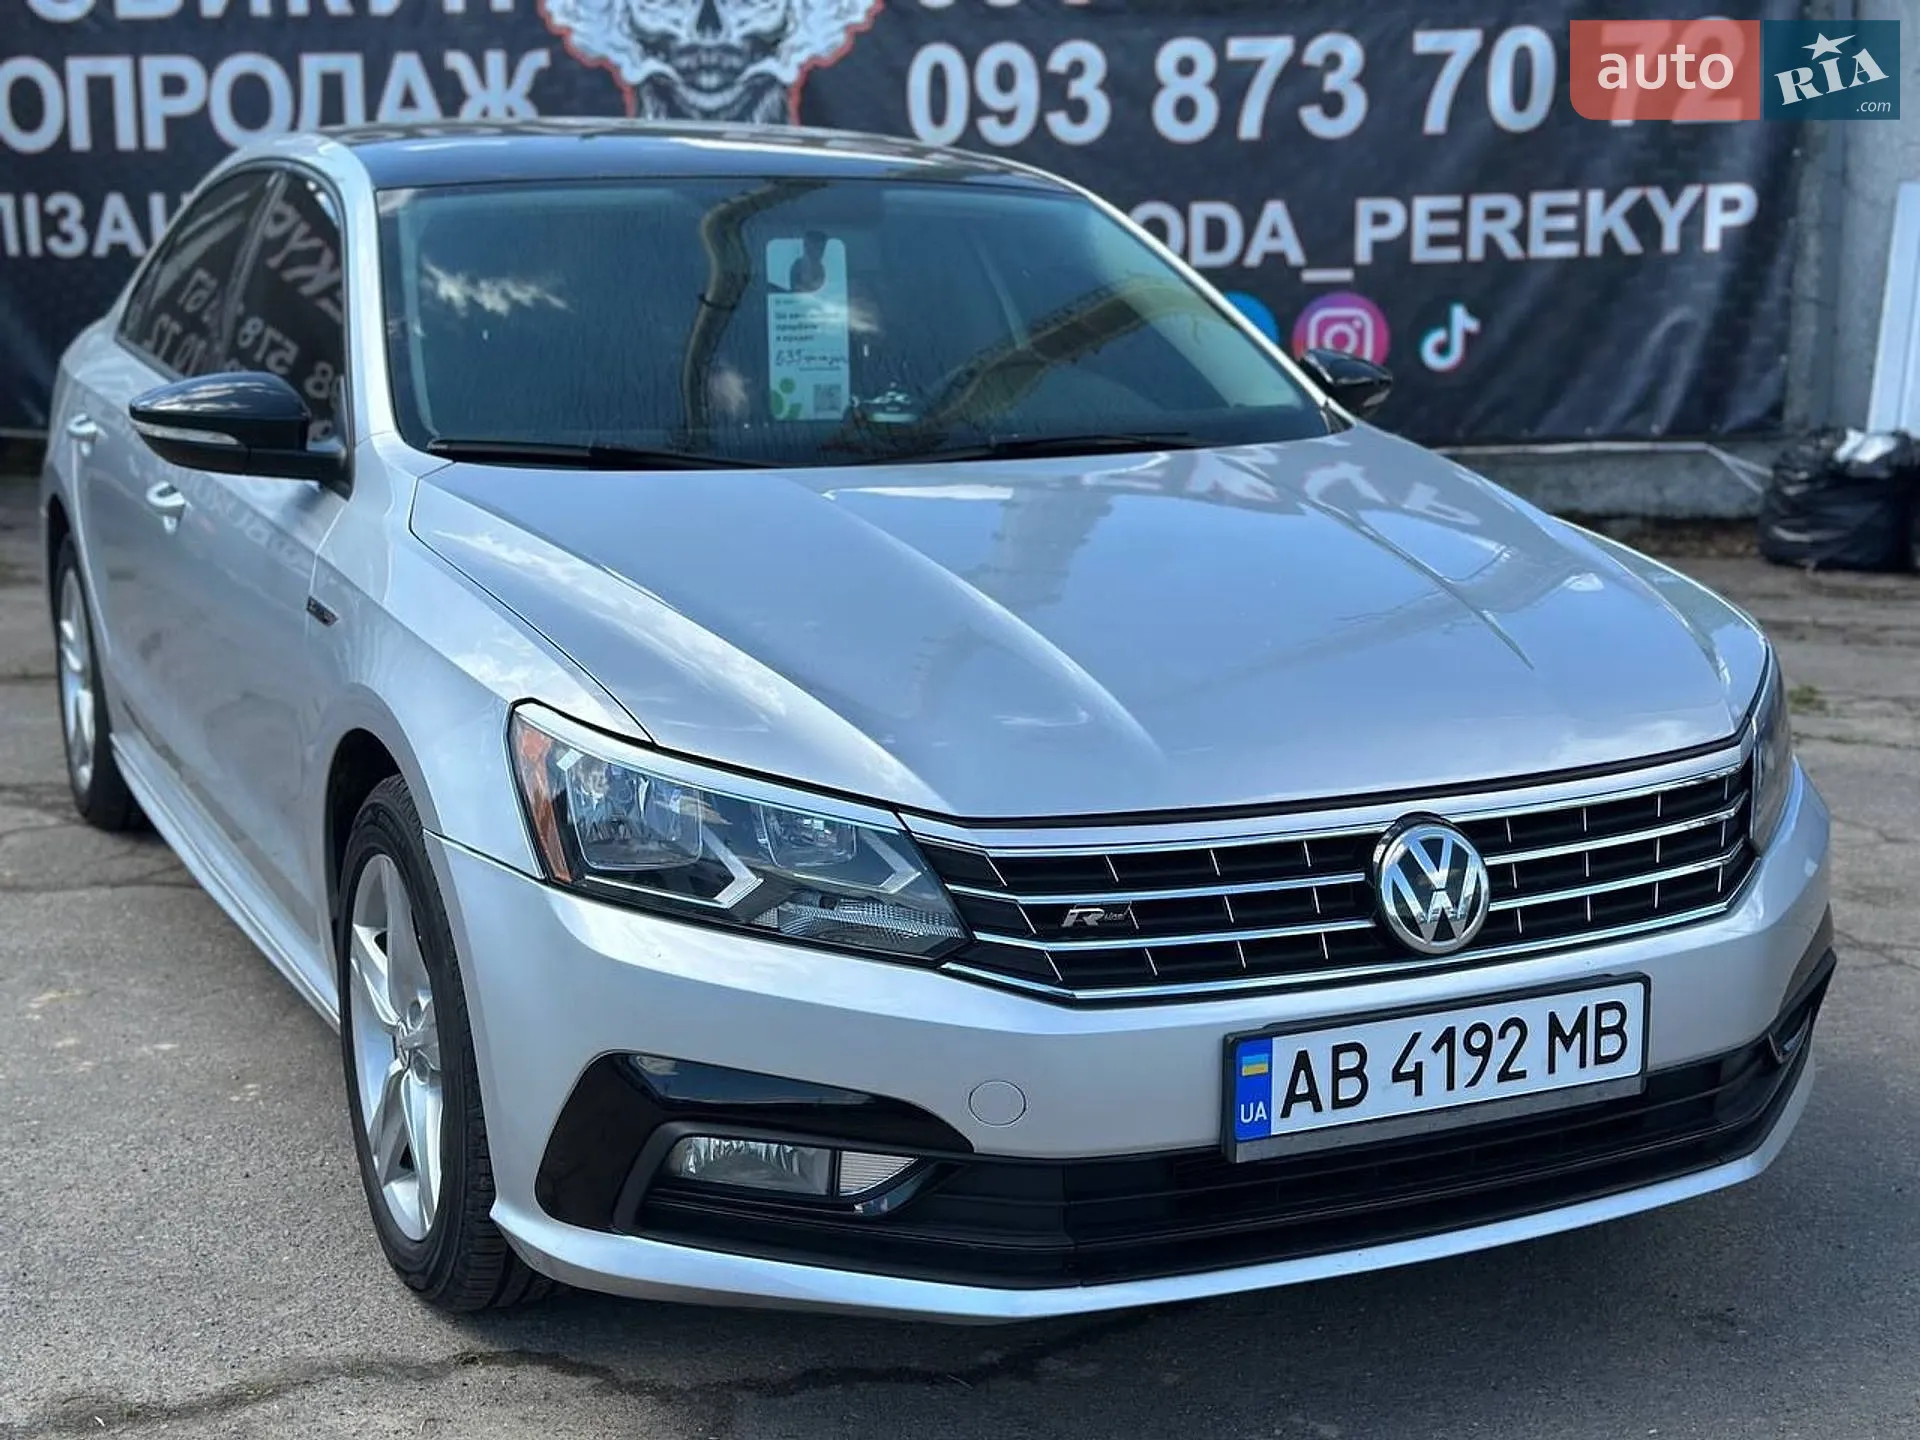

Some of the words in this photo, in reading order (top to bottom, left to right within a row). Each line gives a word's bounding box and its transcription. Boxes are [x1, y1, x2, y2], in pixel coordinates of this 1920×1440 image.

[907, 40, 1111, 147] 093
[1152, 30, 1368, 143] 873
[1412, 25, 1557, 136] 70
[1239, 1102, 1268, 1124] UA
[1280, 1041, 1369, 1119] AB
[1391, 1016, 1529, 1097] 4192
[1547, 1000, 1628, 1076] MB
